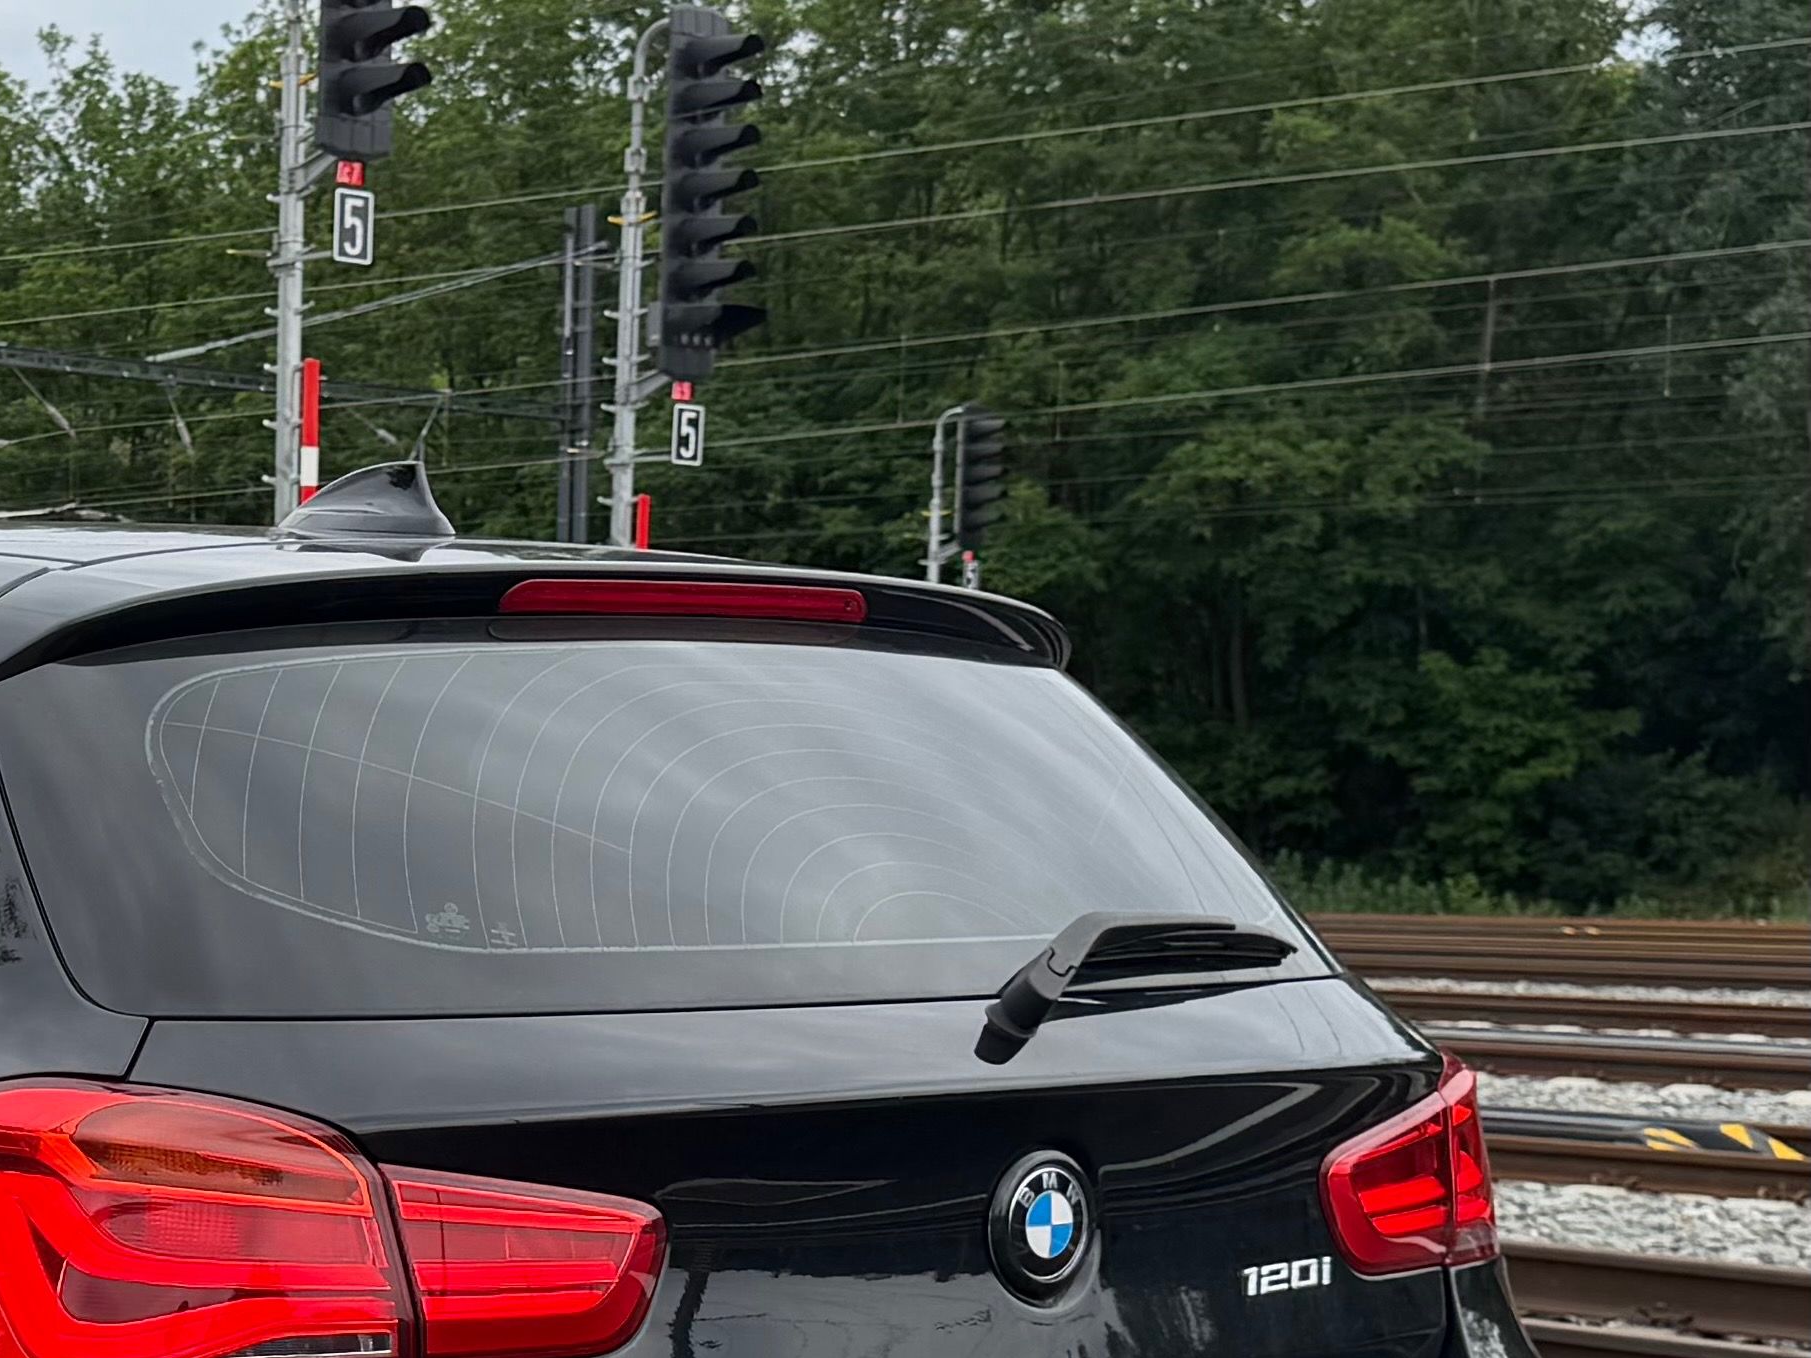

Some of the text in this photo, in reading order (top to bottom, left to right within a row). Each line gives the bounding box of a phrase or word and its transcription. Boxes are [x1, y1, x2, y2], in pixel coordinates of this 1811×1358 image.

[343, 197, 365, 256] 5
[679, 411, 698, 458] 5
[1018, 1172, 1081, 1208] BMW
[1243, 1256, 1331, 1296] 120i
